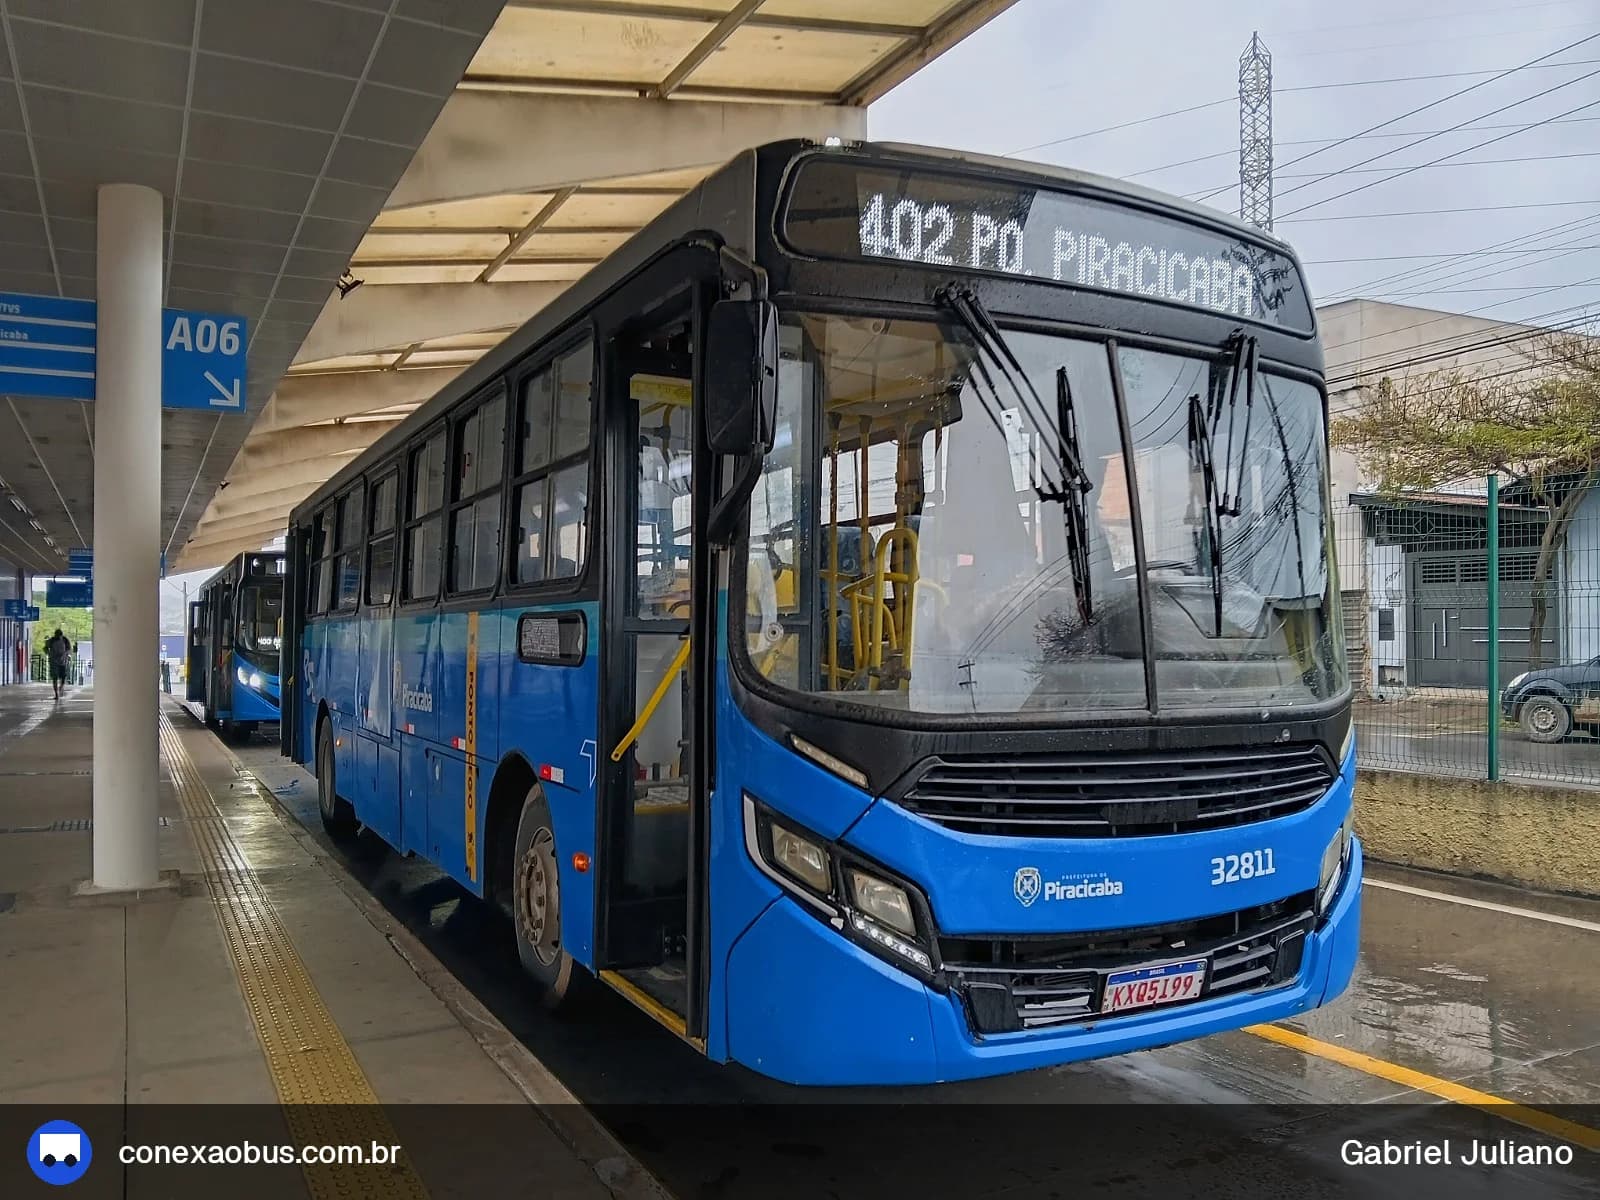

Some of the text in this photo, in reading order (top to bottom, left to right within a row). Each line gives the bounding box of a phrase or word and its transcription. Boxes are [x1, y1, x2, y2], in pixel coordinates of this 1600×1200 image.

[859, 193, 954, 265] 402
[1053, 225, 1253, 316] PIRACICABA
[166, 316, 240, 356] A06
[402, 683, 433, 713] Piracicaba
[1211, 848, 1276, 886] 32811
[1044, 878, 1123, 901] Piracicaba
